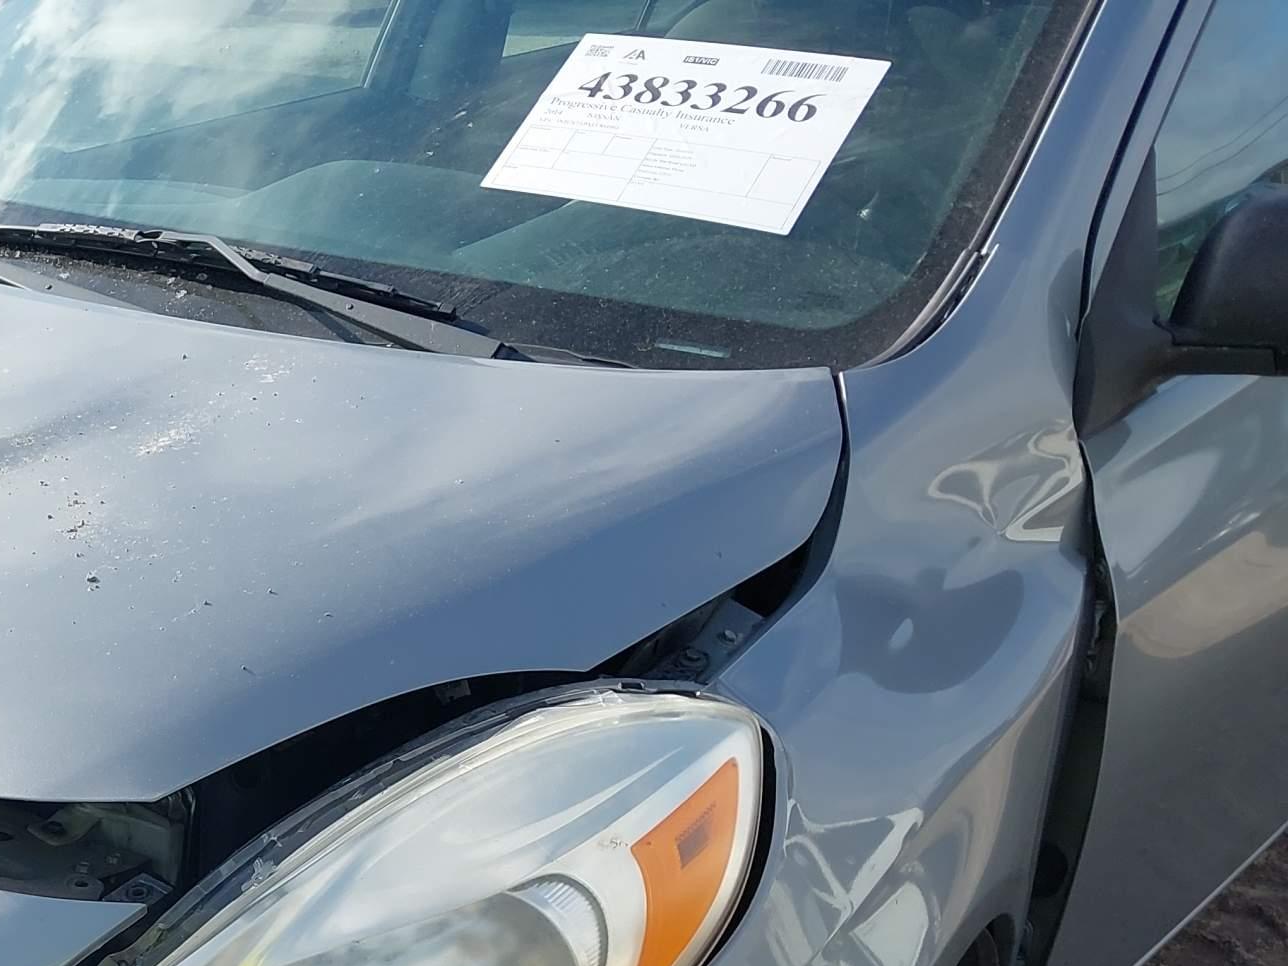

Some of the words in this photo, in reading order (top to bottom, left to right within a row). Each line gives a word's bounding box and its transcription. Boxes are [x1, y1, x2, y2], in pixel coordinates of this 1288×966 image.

[550, 97, 618, 112] Progressive
[620, 104, 672, 119] Casualty
[675, 110, 736, 126] Insurance
[578, 72, 827, 122] 43833266
